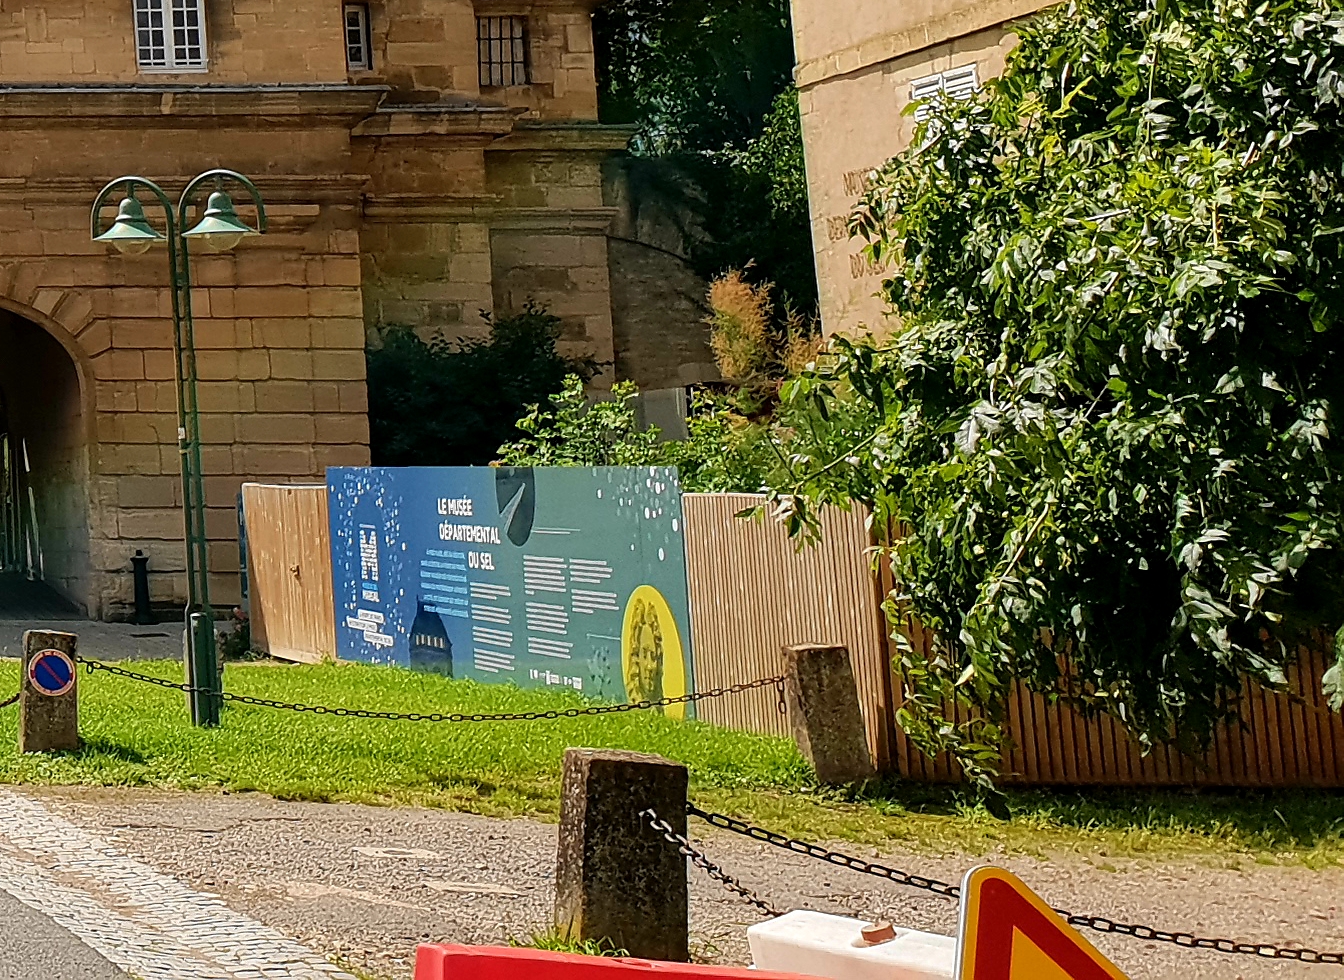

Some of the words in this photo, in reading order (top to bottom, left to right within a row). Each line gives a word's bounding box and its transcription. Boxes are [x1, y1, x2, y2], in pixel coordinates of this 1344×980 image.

[437, 497, 448, 516] LE
[448, 495, 473, 516] MUSÉE
[439, 520, 500, 544] DÉPARTEMENTAL
[468, 551, 479, 569] DU
[480, 553, 494, 570] SEL
